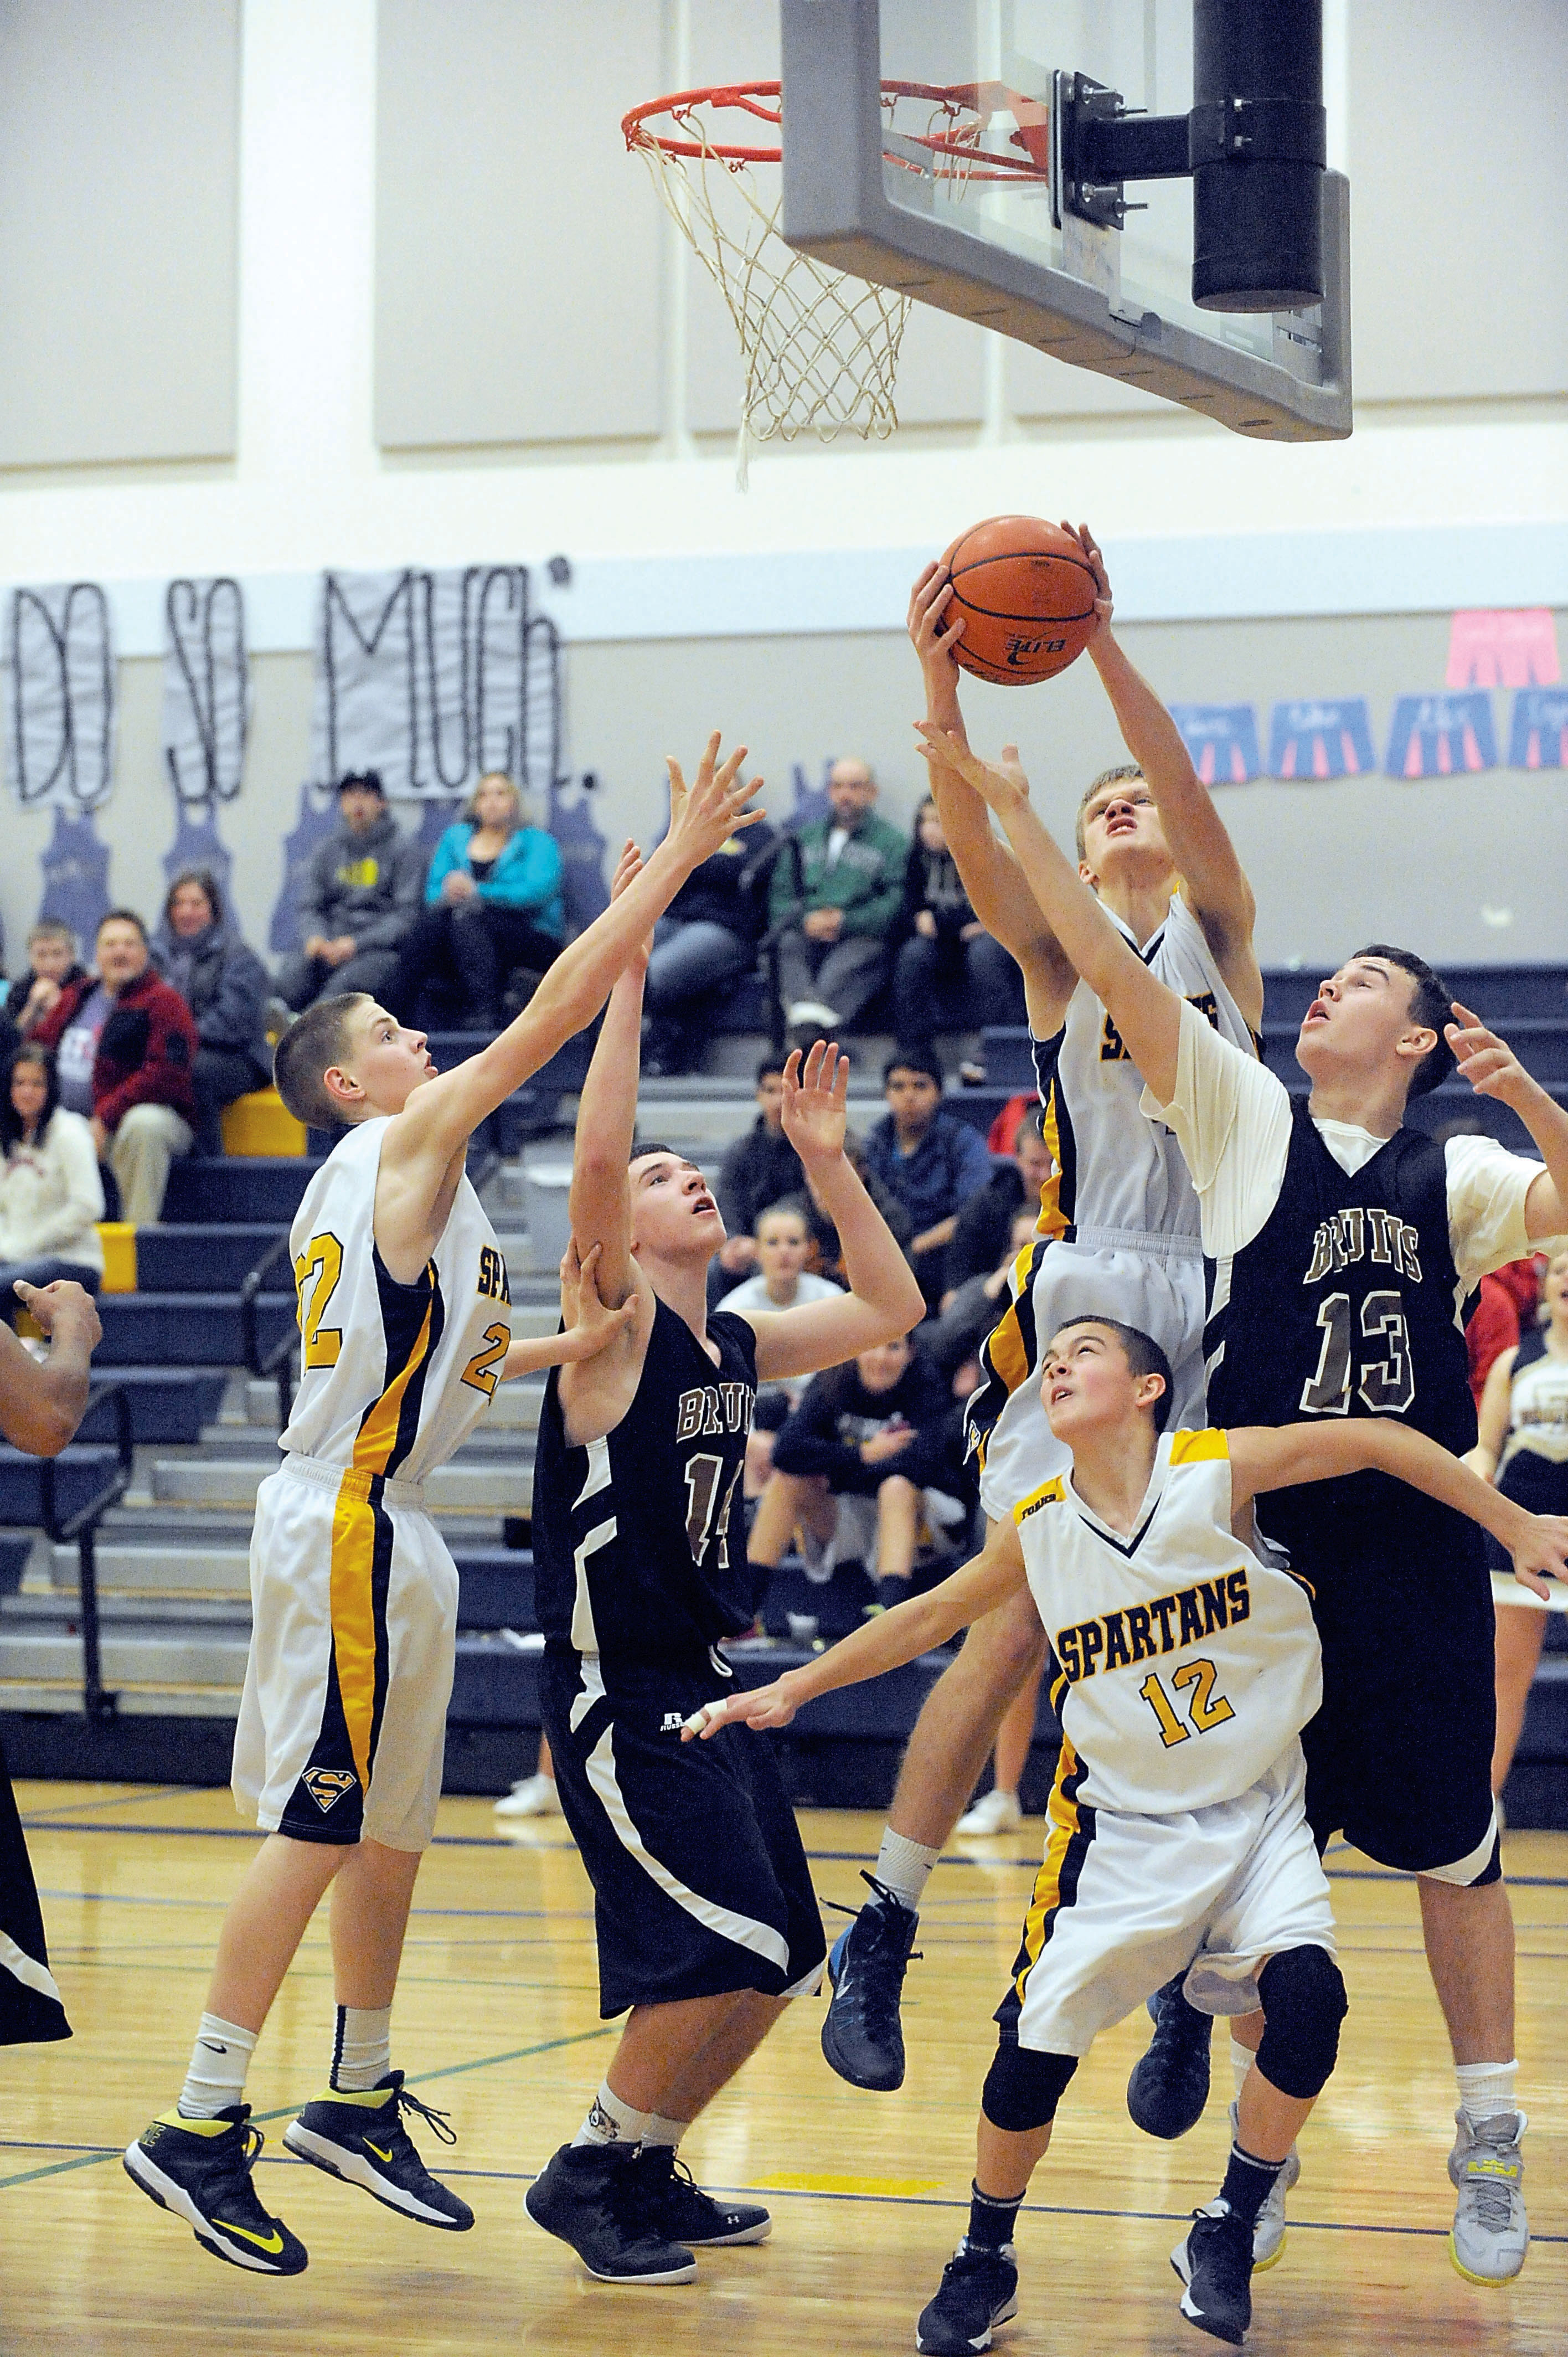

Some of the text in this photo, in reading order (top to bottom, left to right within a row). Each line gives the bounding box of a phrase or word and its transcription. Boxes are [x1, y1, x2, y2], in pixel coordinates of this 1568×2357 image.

[13, 583, 114, 801] DO
[167, 578, 248, 802] SO
[1299, 1291, 1415, 1414] 13
[1056, 1566, 1250, 1684] SPARTANS
[1138, 1658, 1236, 1749] 12
